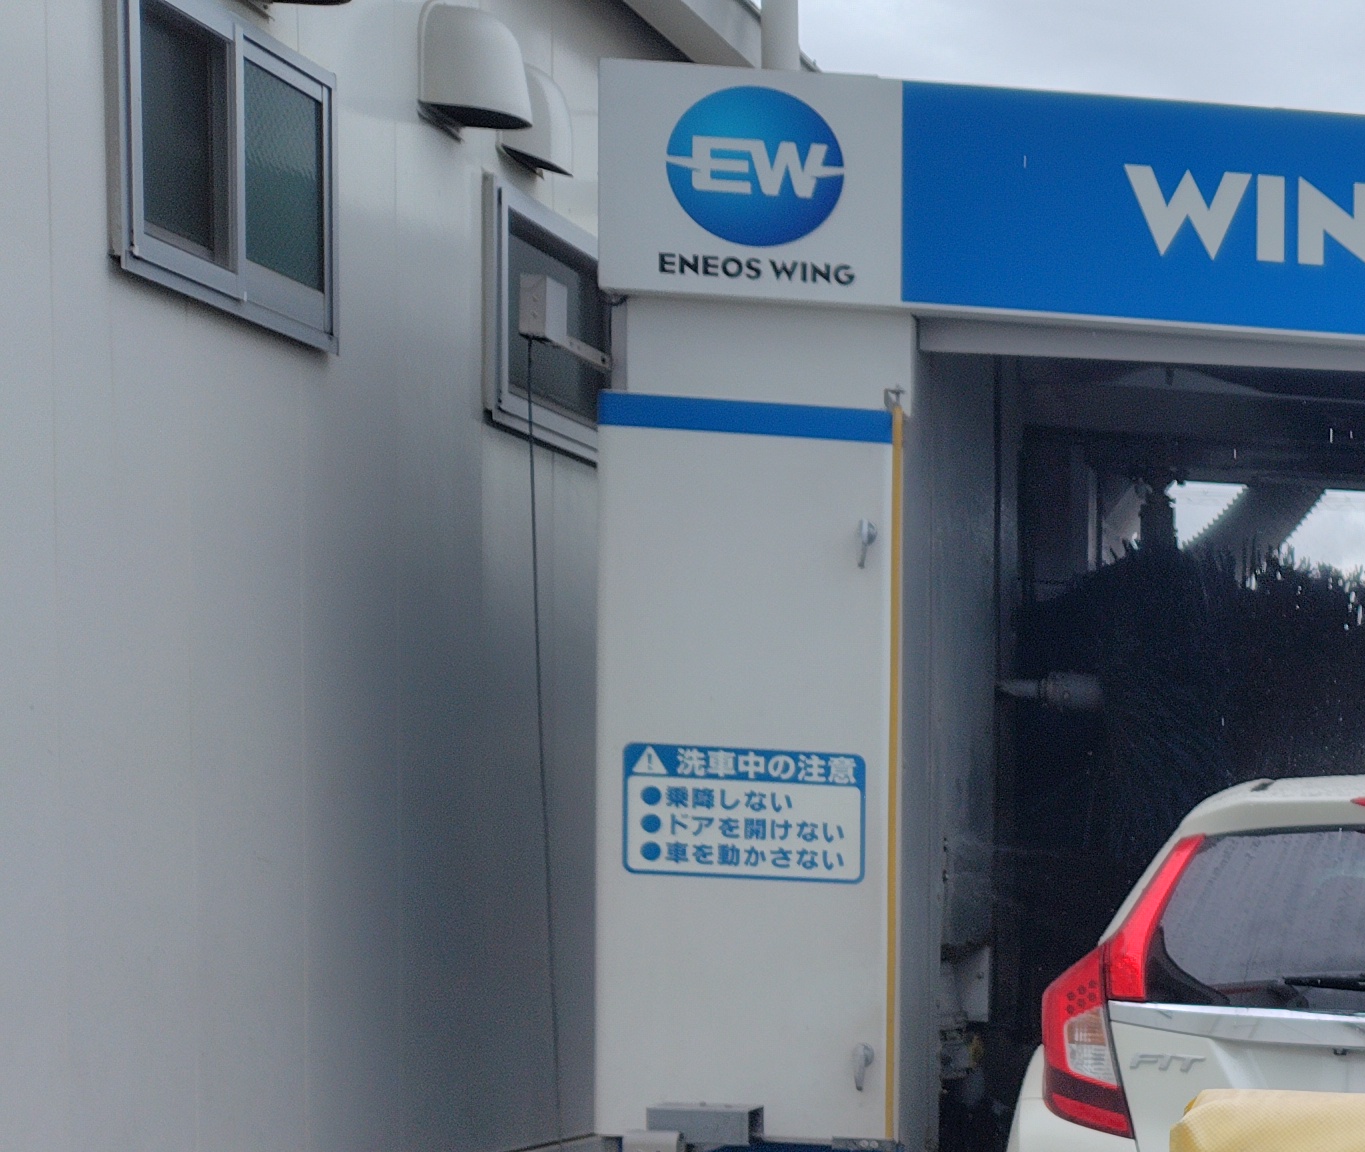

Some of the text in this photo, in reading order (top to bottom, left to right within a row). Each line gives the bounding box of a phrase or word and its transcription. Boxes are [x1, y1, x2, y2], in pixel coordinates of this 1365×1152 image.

[690, 134, 830, 199] EW
[658, 251, 856, 285] ENEOS WING
[676, 747, 857, 784] 洗車中の注意
[665, 785, 793, 812] 乗降しない
[669, 813, 845, 843] ドアを開けない
[665, 841, 845, 870] 車を動かさない
[1129, 1053, 1207, 1073] FIT
